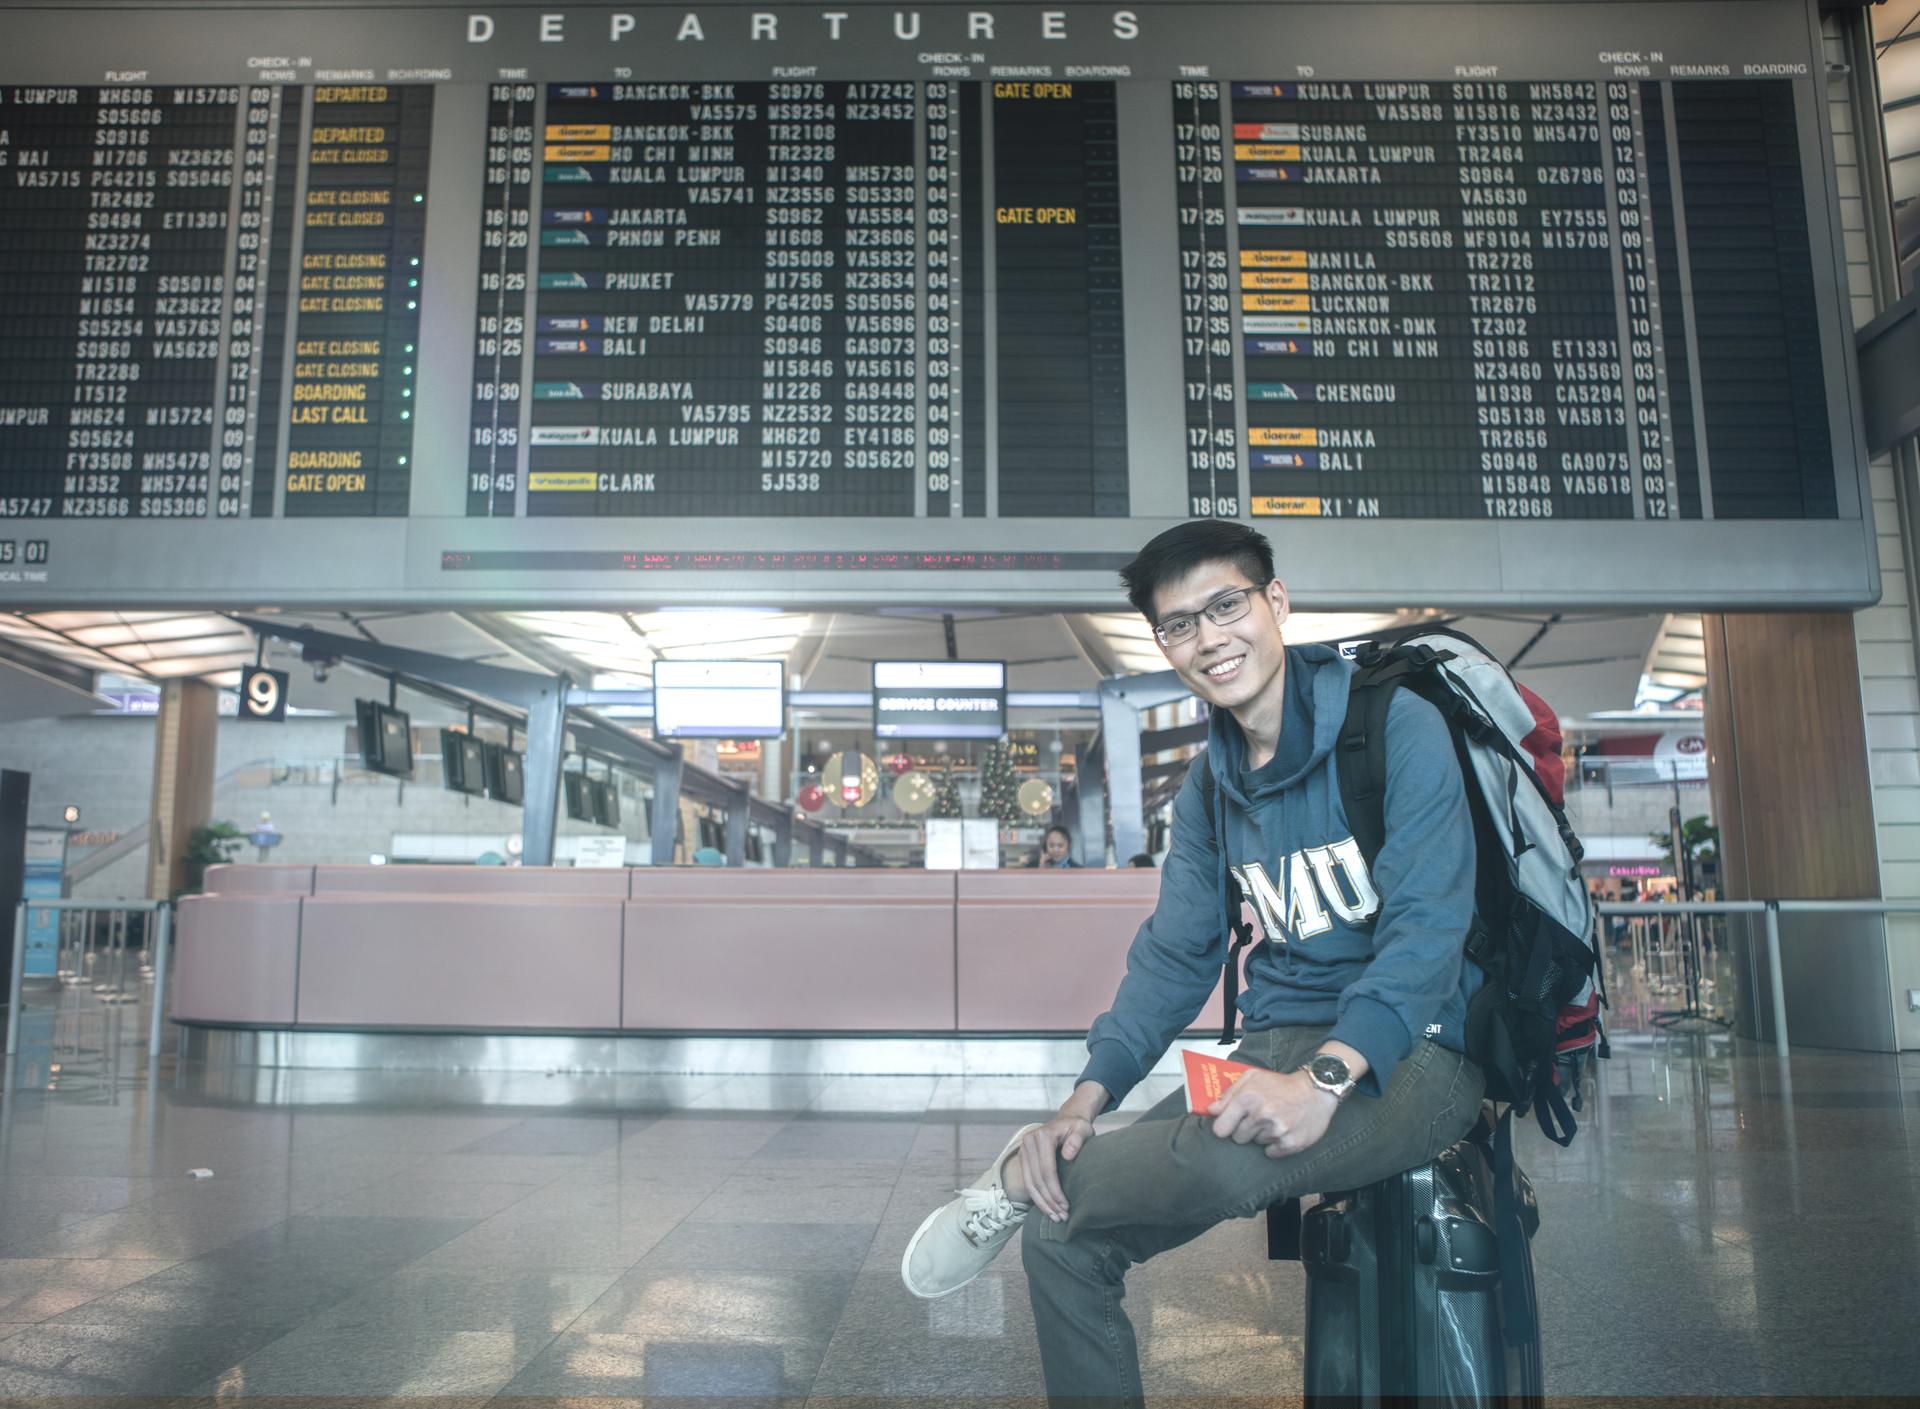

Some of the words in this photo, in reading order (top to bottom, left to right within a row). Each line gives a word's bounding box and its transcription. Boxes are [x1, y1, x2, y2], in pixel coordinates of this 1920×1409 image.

[467, 11, 1139, 42] DEPARTURES
[106, 71, 148, 81] FLIGHT
[499, 68, 526, 79] TIME
[614, 67, 632, 78] TO
[773, 66, 817, 77] FLIGHT
[933, 66, 970, 76] ROWS
[990, 66, 1052, 76] REMARKS
[1065, 65, 1131, 76] BOARDING
[1180, 66, 1208, 76] TIME
[1296, 66, 1314, 77] TO
[1455, 65, 1498, 77] FLIGHT
[1614, 65, 1650, 76] ROWS
[1670, 65, 1729, 76] REMARKS
[1744, 64, 1807, 75] BOARDING
[14, 89, 78, 104] LUMPUR
[315, 86, 387, 103] DEPARTED
[995, 83, 1030, 98] GATE
[1034, 83, 1071, 98] OPEN
[1297, 84, 1352, 100] KUALA
[1364, 84, 1430, 100] LUMPUR
[312, 128, 384, 143] DEPARTED
[1300, 125, 1366, 141] SUBANG
[311, 149, 340, 163] GATE
[342, 149, 388, 162] CLOSED
[611, 145, 632, 162] HO
[645, 146, 675, 162] CHI
[689, 146, 733, 161] MINH
[1302, 146, 1357, 162] KUALA
[1369, 146, 1435, 162] LUMPUR
[610, 167, 665, 183] KUALA
[678, 167, 744, 183] LUMPUR
[1304, 167, 1381, 183] JAKARTA
[307, 191, 336, 205] GATE
[339, 191, 389, 204] CLOSING
[306, 212, 335, 226] GATE
[338, 212, 384, 225] CLOSED
[608, 209, 687, 225] JAKARTA
[997, 208, 1033, 223] GATE
[1037, 208, 1075, 223] OPEN
[1307, 210, 1361, 226] KUALA
[1374, 210, 1440, 226] LUMPUR
[607, 230, 663, 246] PHNOM
[675, 230, 720, 246] PENH
[303, 255, 332, 268] GATE
[335, 254, 385, 268] CLOSING
[1308, 251, 1375, 267] MANILA
[301, 276, 330, 290] GATE
[333, 276, 384, 290] CLOSING
[606, 273, 673, 289] PHUKET
[1310, 274, 1433, 291] BANGKOK-BKK
[300, 298, 329, 311] GATE
[332, 297, 382, 311] CLOSING
[1311, 296, 1389, 313] LUCKNOW
[604, 317, 638, 333] NEW
[650, 316, 704, 333] DELHI
[1312, 318, 1436, 335] BANGKOK-DMK
[297, 342, 326, 355] GATE
[329, 341, 380, 355] CLOSING
[603, 339, 645, 355] BALI
[1313, 340, 1335, 357] HO
[1348, 340, 1378, 357] CHI
[1393, 340, 1438, 357] MINH
[296, 364, 324, 377] GATE
[327, 363, 378, 377] CLOSING
[294, 384, 365, 400] BOARDING
[601, 383, 693, 400] SURABAYA
[1316, 384, 1395, 402] CHENGDU
[292, 407, 328, 423] LAST
[332, 407, 368, 423] CALL
[600, 428, 657, 445] KUALA
[670, 428, 738, 445] LUMPUR
[1318, 430, 1375, 447] DHAKA
[289, 452, 361, 468] BOARDING
[1319, 453, 1362, 470] BALI
[288, 475, 323, 491] GATE
[327, 474, 365, 491] OPEN
[599, 474, 654, 491] CLARK
[248, 672, 279, 716] 9
[879, 698, 934, 711] SERVICE
[936, 698, 998, 711] COUNTER
